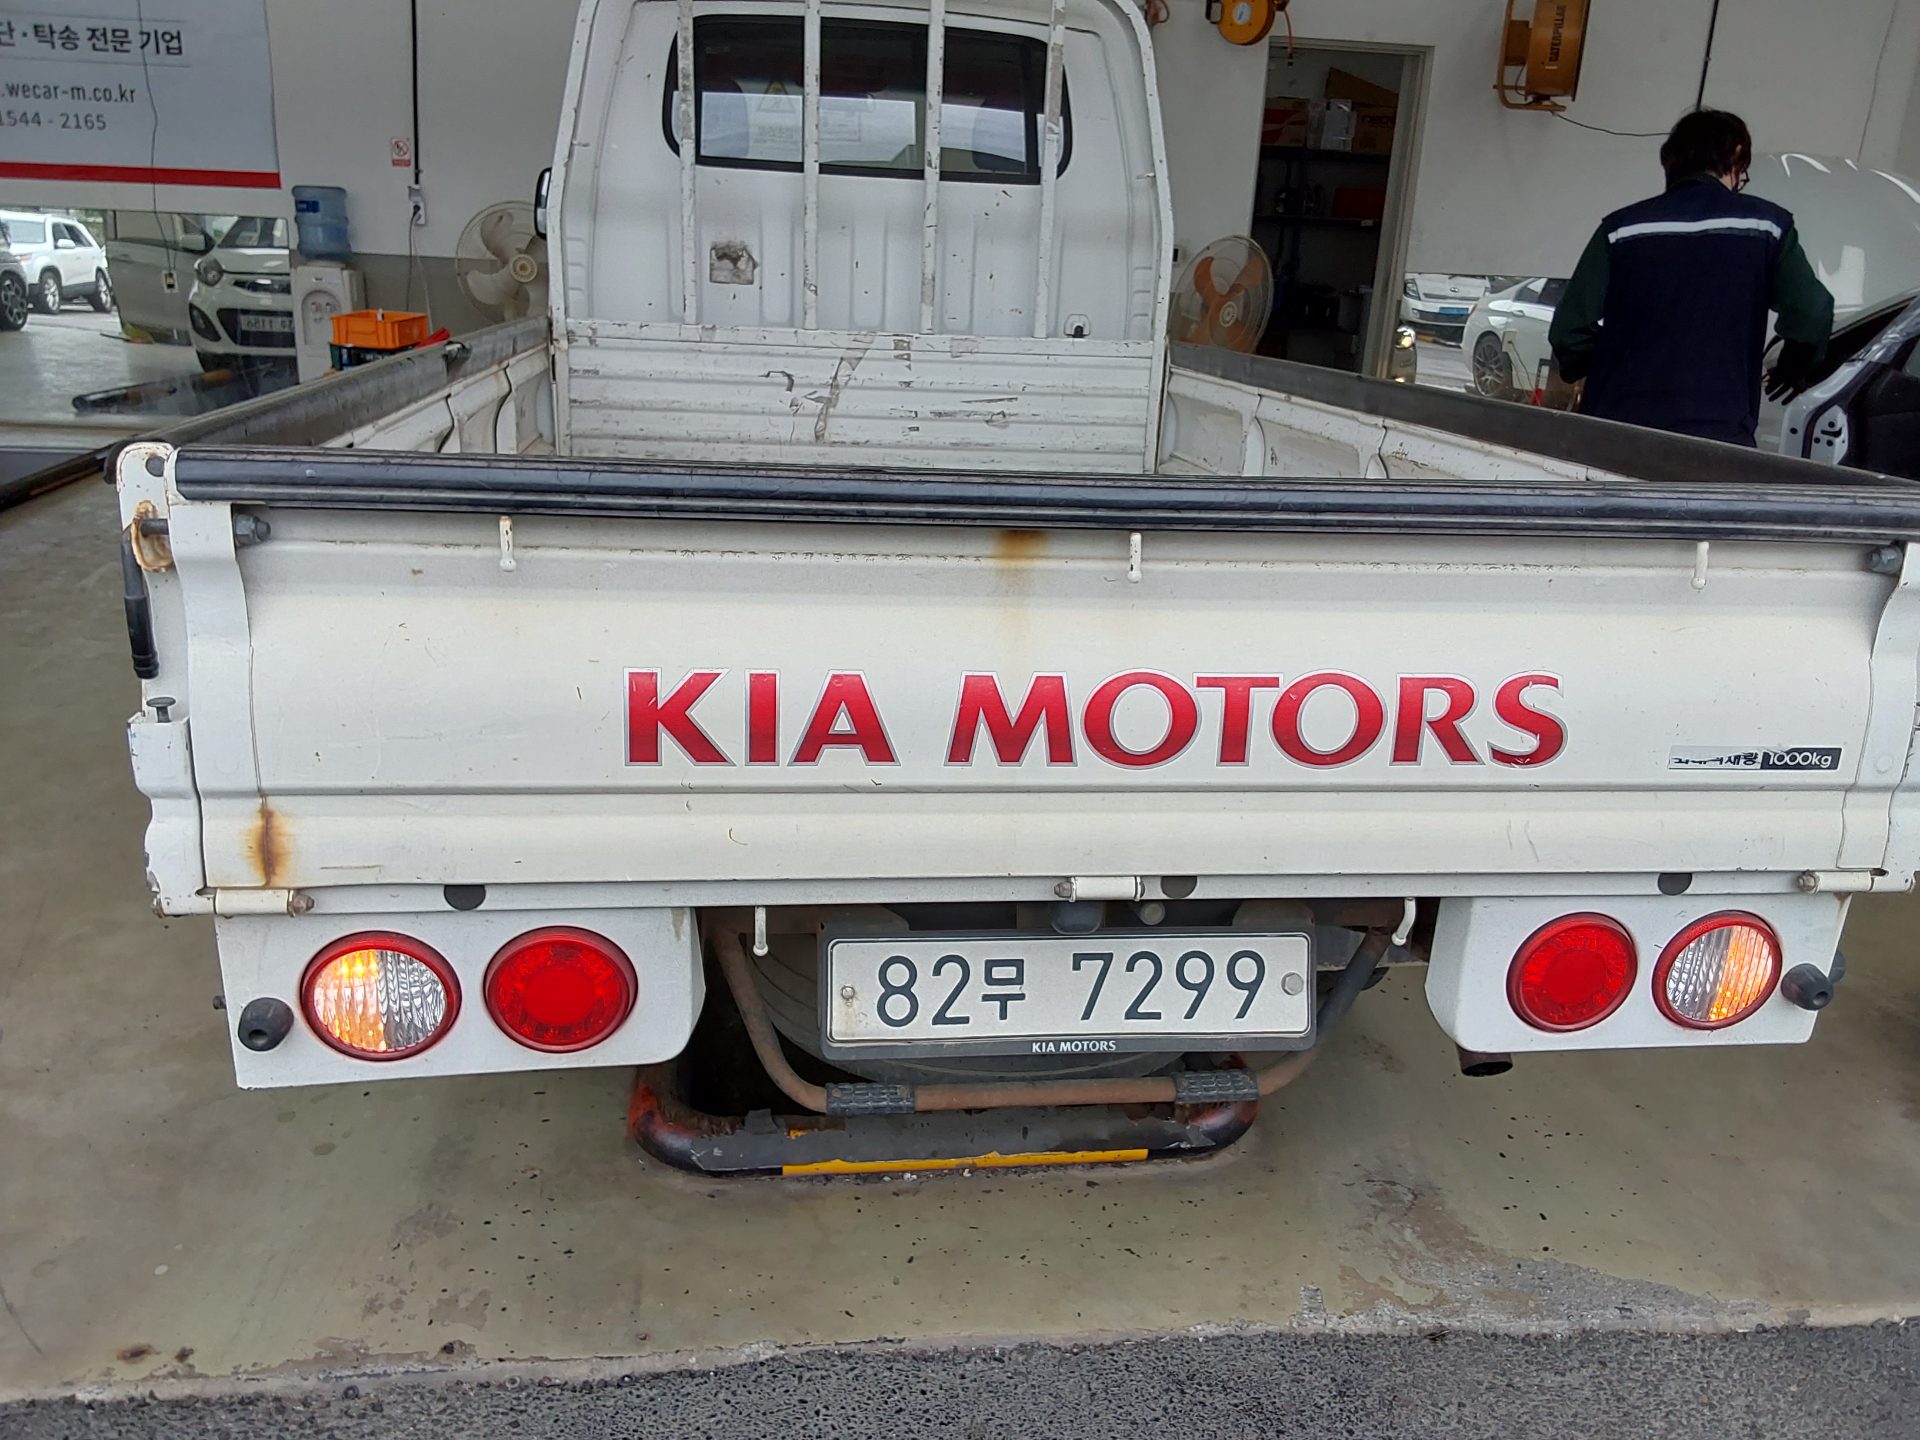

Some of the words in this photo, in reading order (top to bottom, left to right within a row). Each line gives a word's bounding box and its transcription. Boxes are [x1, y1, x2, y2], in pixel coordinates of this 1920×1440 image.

[86, 26, 132, 53] 전문
[139, 29, 183, 56] 기업
[60, 112, 107, 131] 2165
[623, 667, 902, 767] KIA
[944, 669, 1569, 770] MOTORS
[1768, 751, 1832, 768] 1000kg
[876, 954, 1026, 1028] 82무
[1072, 949, 1266, 1021] 7299
[1032, 1041, 1056, 1053] KIA
[1059, 1040, 1117, 1052] MOTORS
